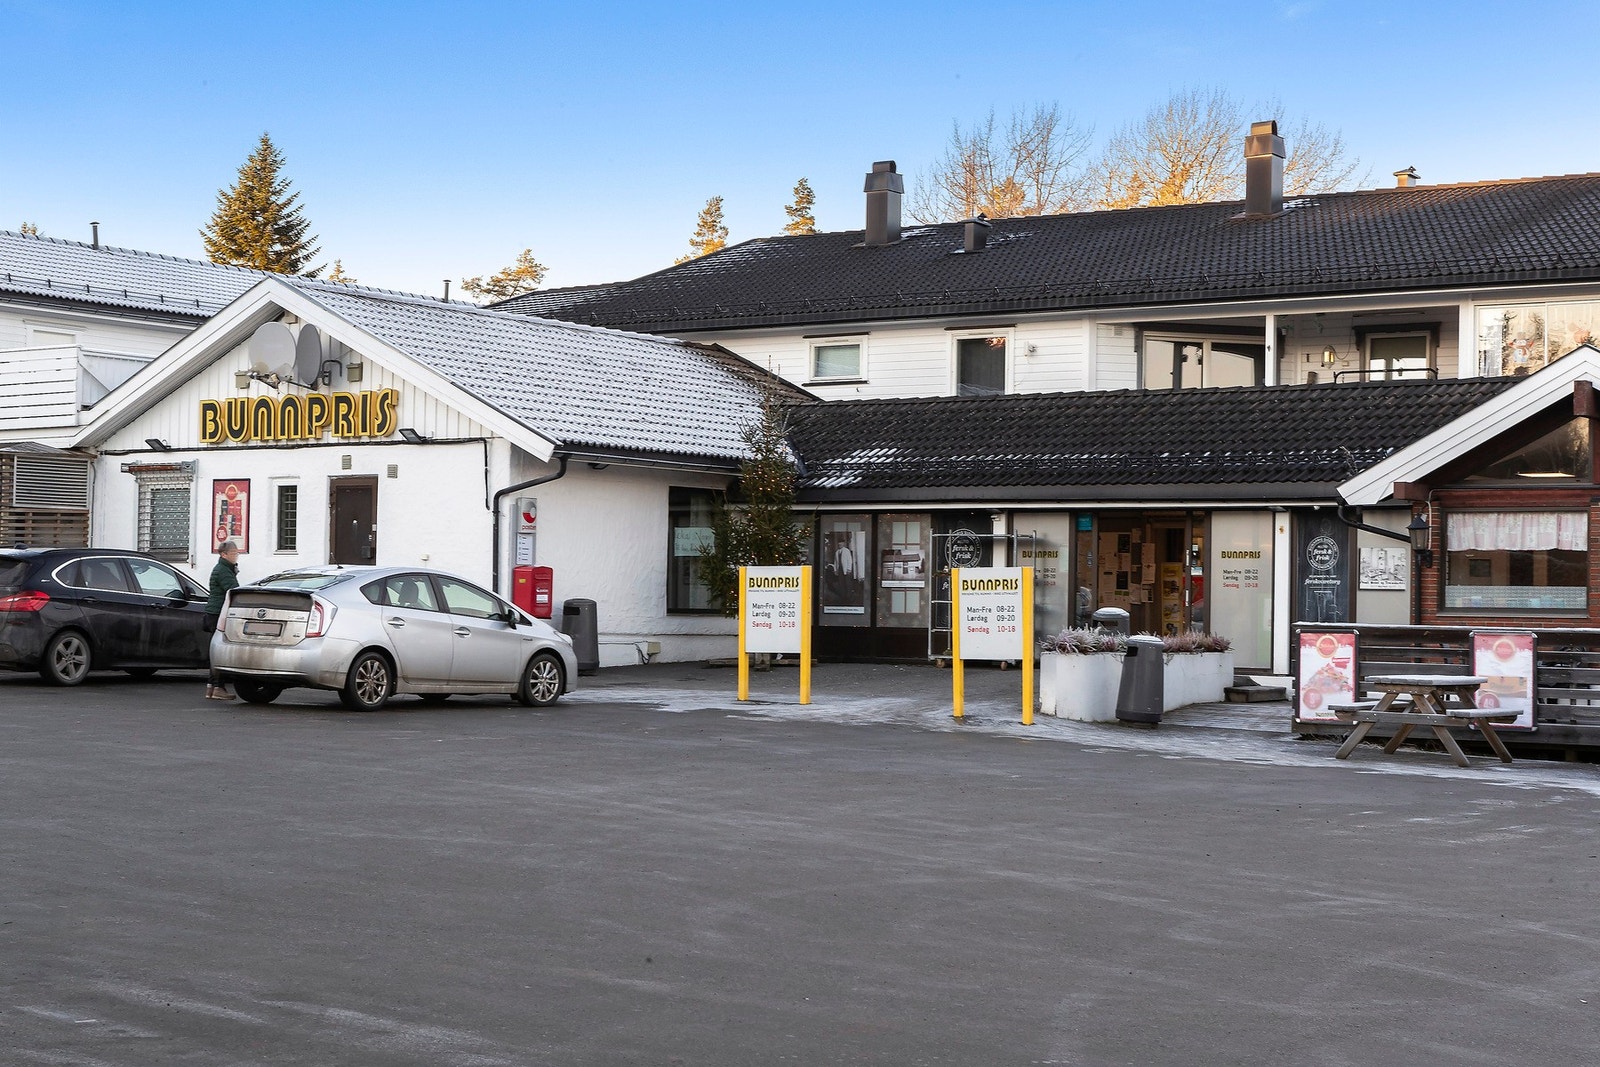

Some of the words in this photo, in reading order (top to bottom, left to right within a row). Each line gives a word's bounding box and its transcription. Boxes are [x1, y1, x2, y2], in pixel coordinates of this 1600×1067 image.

[199, 388, 398, 444] BUNNPRIS
[1221, 551, 1261, 559] BUNNPRIS
[748, 577, 800, 588] BUNNPRIS
[962, 578, 1018, 591] BUNNPRIS
[966, 615, 988, 623] Lørdag
[752, 621, 772, 629] Søndag
[967, 626, 990, 634] Søndag
